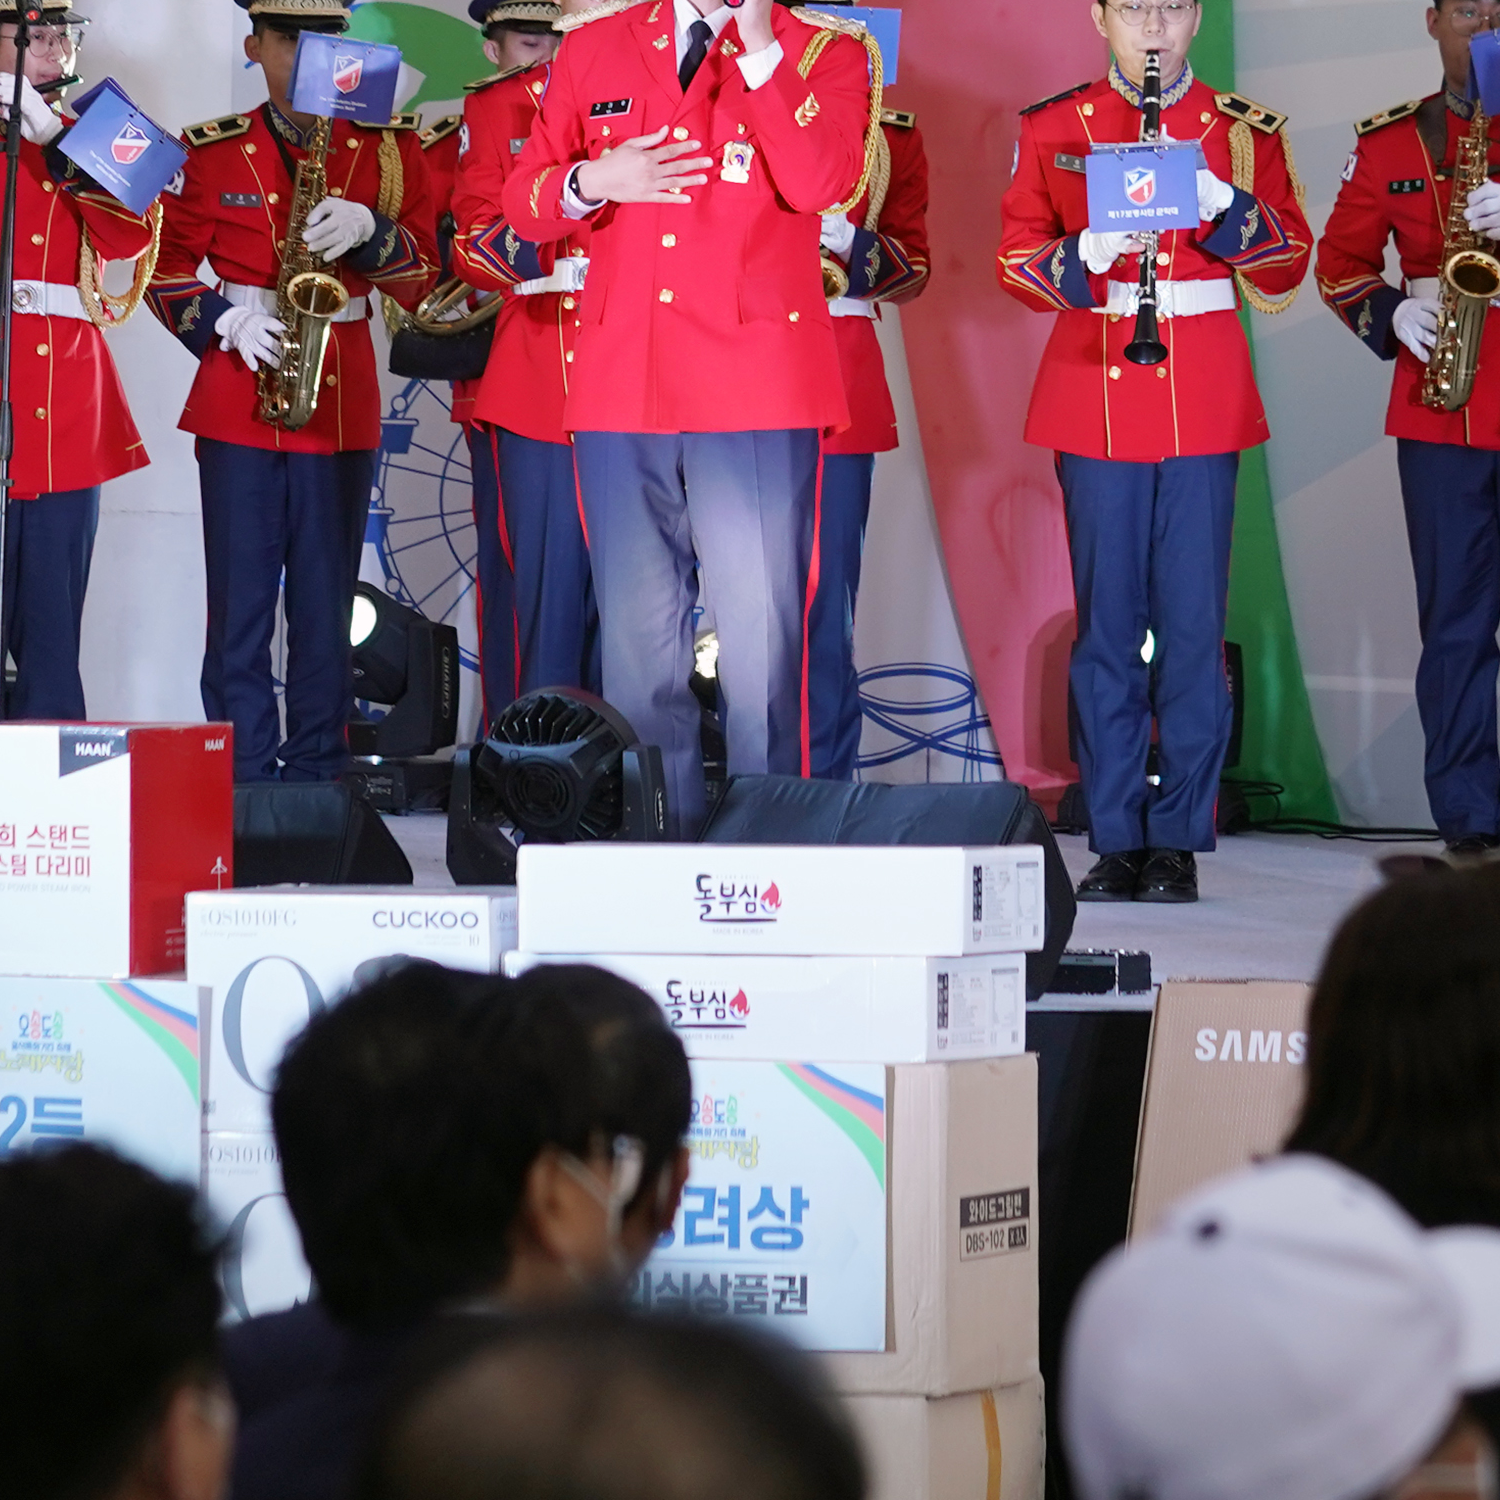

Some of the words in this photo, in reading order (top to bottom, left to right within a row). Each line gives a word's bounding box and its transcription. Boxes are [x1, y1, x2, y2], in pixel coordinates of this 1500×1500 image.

[75, 742, 112, 757] HAAN
[204, 738, 225, 752] HAAN
[26, 824, 91, 850] 스탠드
[35, 855, 91, 878] 다리미
[694, 873, 762, 922] 돌부심
[372, 910, 479, 929] CUCKOO
[665, 980, 732, 1030] 돌부심
[19, 1010, 63, 1040] 오송도송
[1194, 1028, 1309, 1065] SAMS
[660, 1185, 811, 1251] 려상
[965, 1228, 1005, 1254] DBS-102
